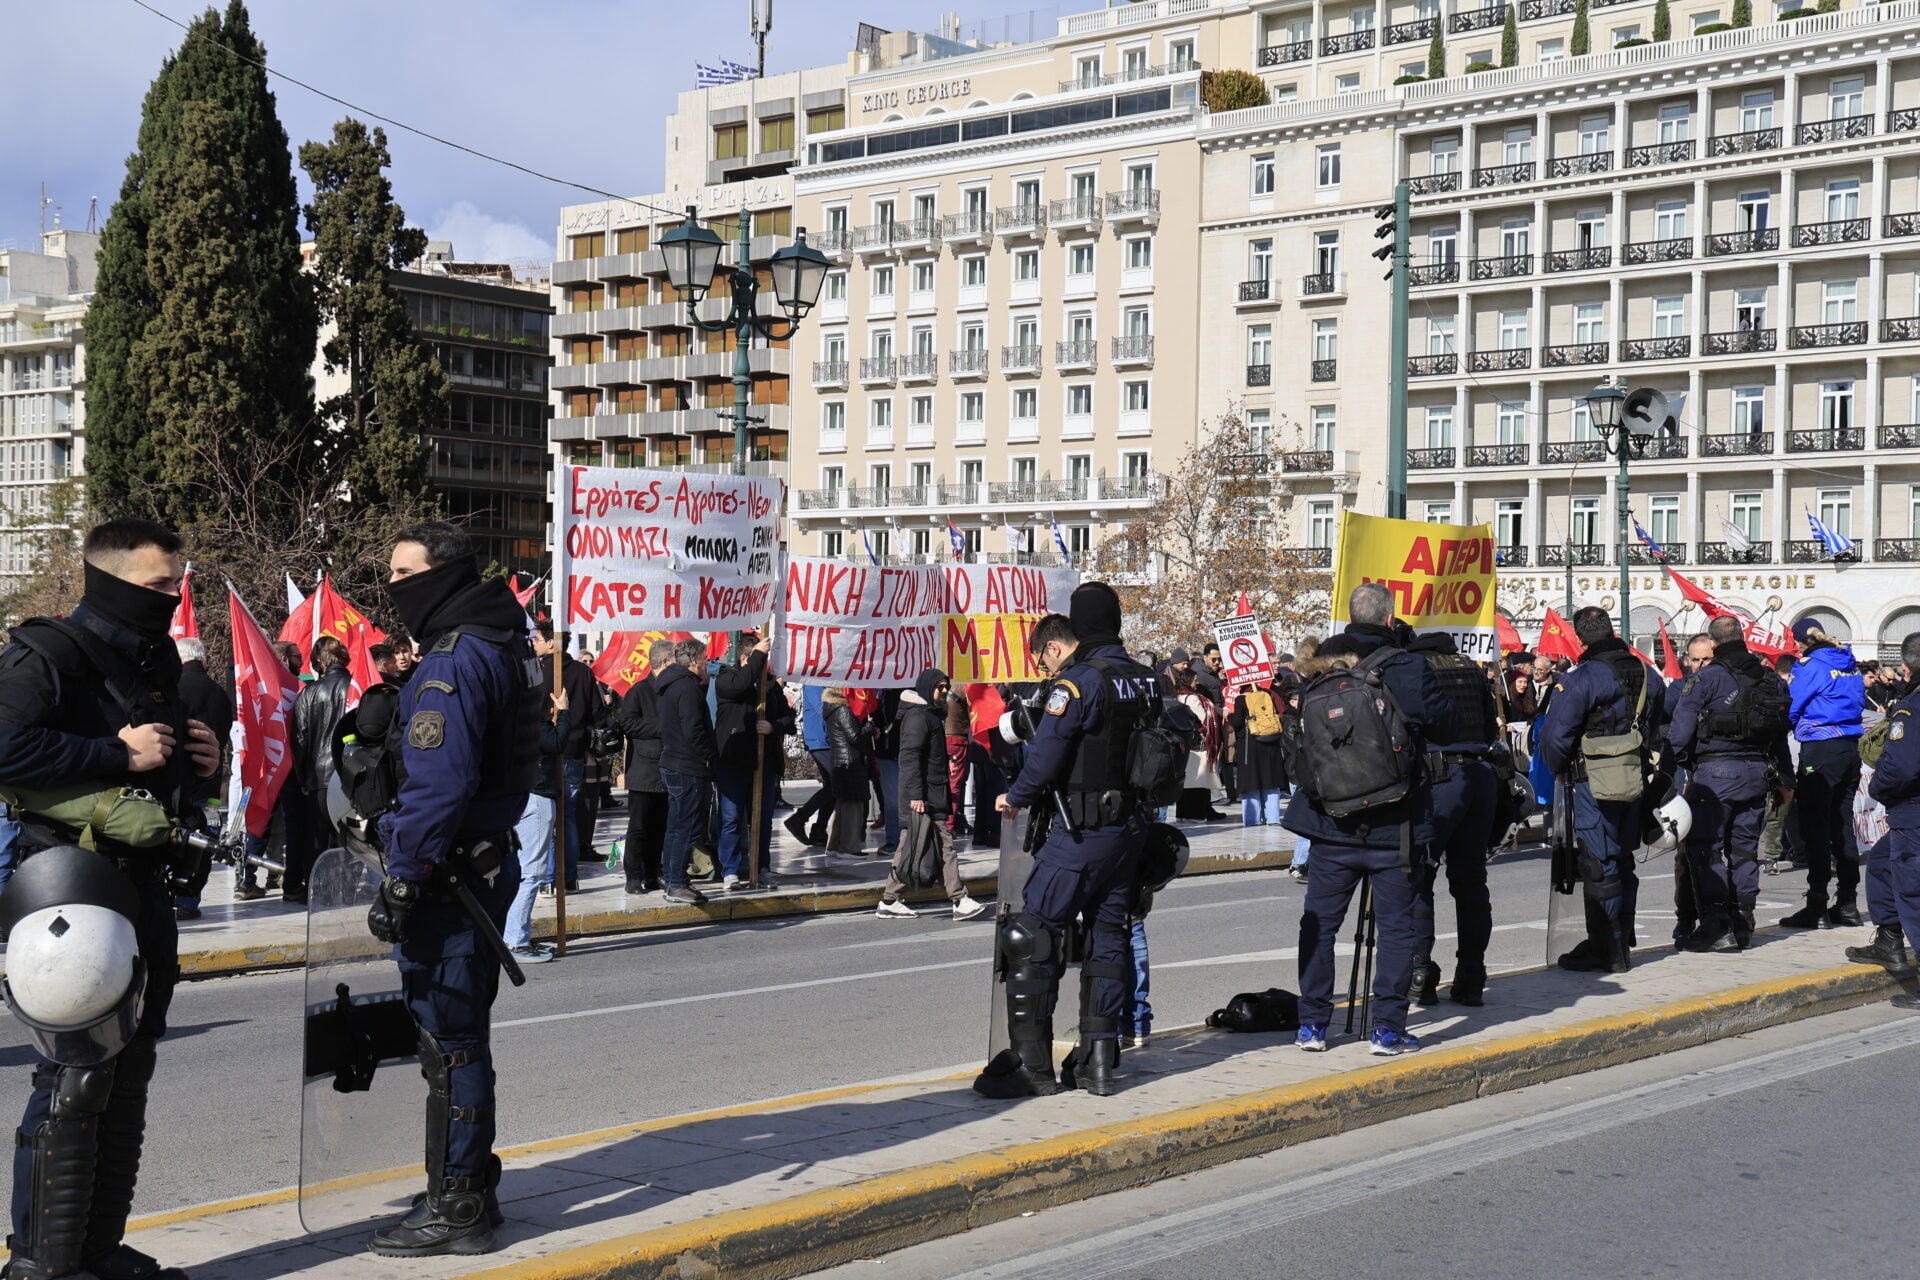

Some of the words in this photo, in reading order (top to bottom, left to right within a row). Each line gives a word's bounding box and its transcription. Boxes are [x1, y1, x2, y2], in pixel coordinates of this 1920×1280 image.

[862, 94, 899, 113] KING
[906, 79, 971, 105] GEORGE
[708, 184, 786, 212] PLAZA
[566, 523, 614, 560] ΟΛΟΙ
[684, 535, 739, 564] ΜΠΛΟΚΑ
[567, 574, 648, 625] ΚΑΤΩ
[663, 583, 682, 619] Η
[785, 561, 867, 617] ΝΙΚΗ
[871, 568, 919, 618] ΣΤΟΝ
[985, 566, 1049, 615] ΑΓΩΝΑ
[1361, 576, 1483, 617] ΠΛΟΚΟ
[1497, 576, 1565, 592] HOTEL
[1577, 575, 1671, 591] GRANDE
[784, 622, 842, 678] ΤΗΣ
